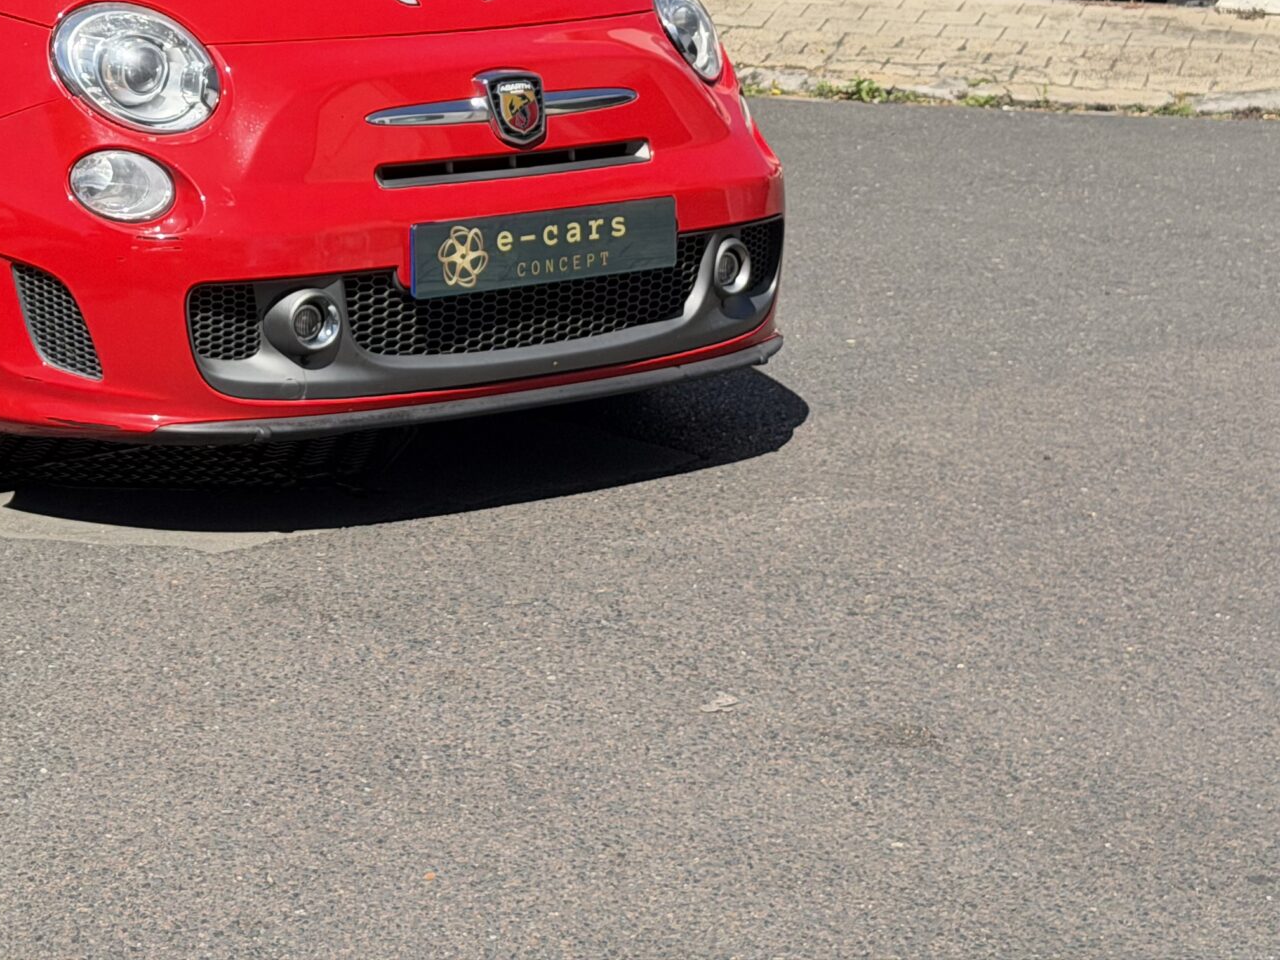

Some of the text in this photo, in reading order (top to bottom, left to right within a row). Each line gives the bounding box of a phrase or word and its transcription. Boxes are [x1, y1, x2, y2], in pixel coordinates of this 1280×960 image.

[500, 82, 531, 91] ABARTH
[496, 216, 626, 252] e-cars
[516, 251, 609, 277] CONCEPT
